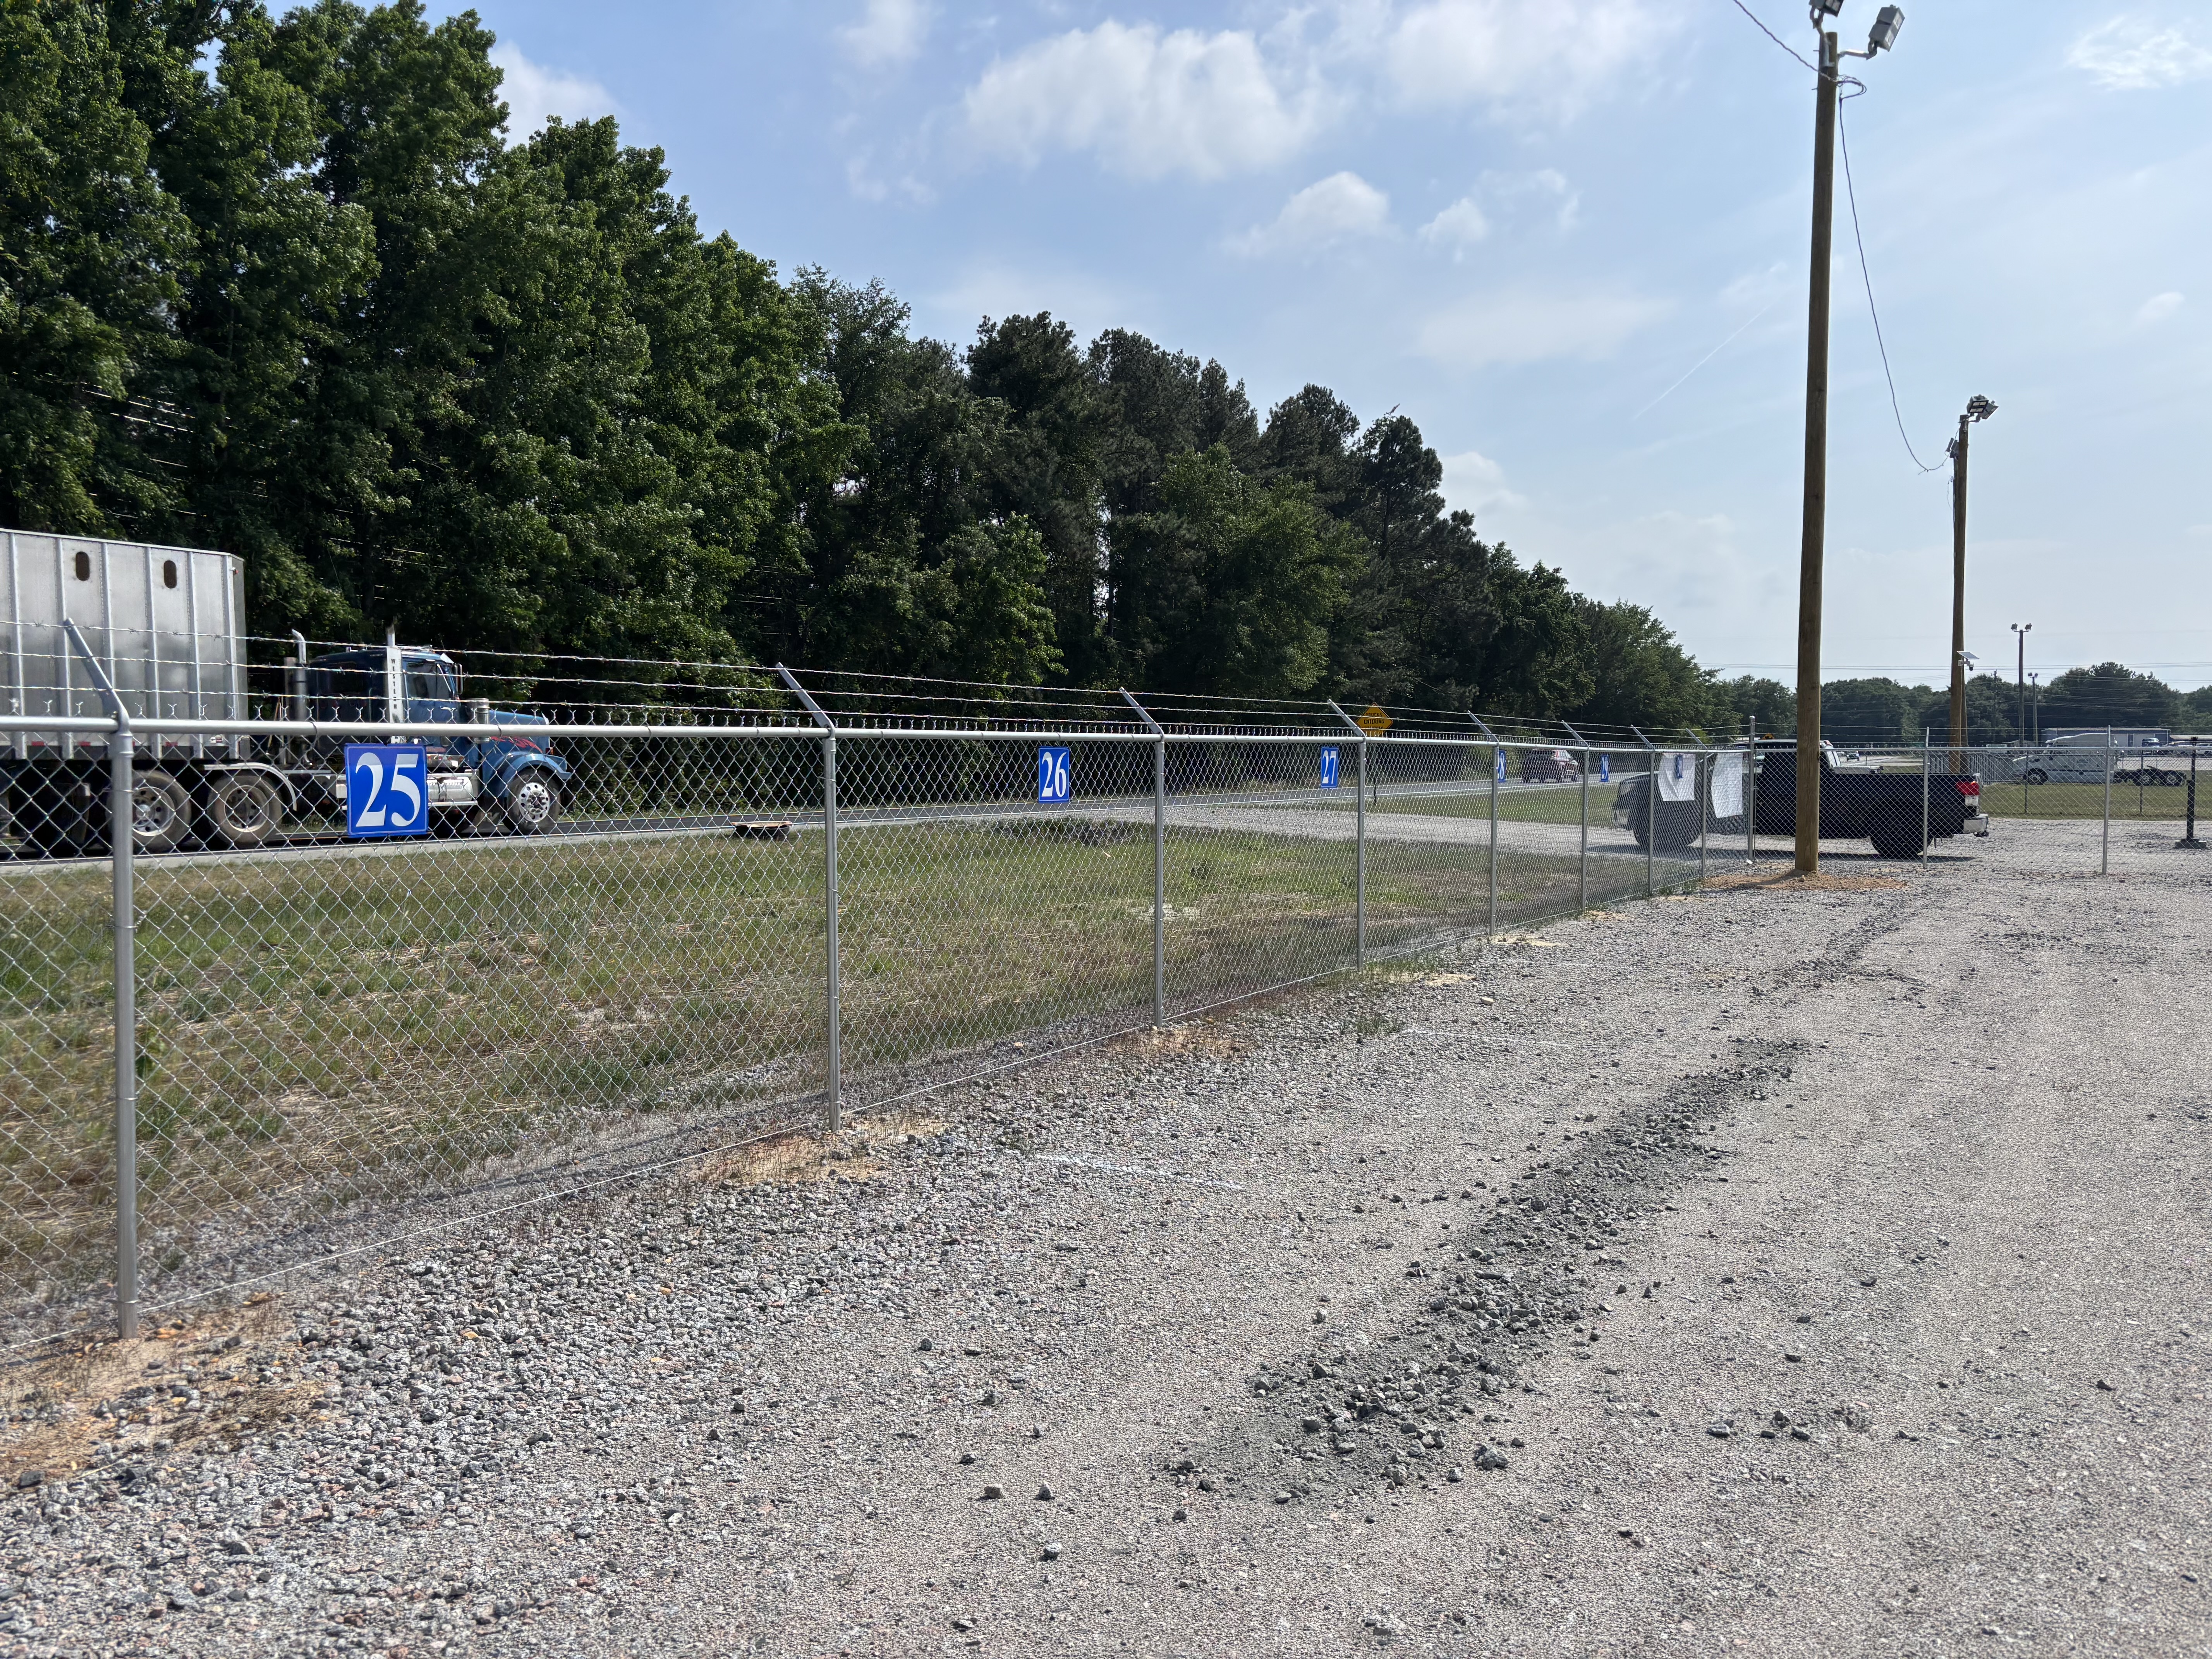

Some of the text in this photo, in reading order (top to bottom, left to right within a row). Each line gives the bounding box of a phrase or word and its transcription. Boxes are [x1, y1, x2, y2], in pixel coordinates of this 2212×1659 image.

[355, 752, 421, 827] 25
[1041, 752, 1066, 797] 26
[1322, 750, 1337, 784] 27
